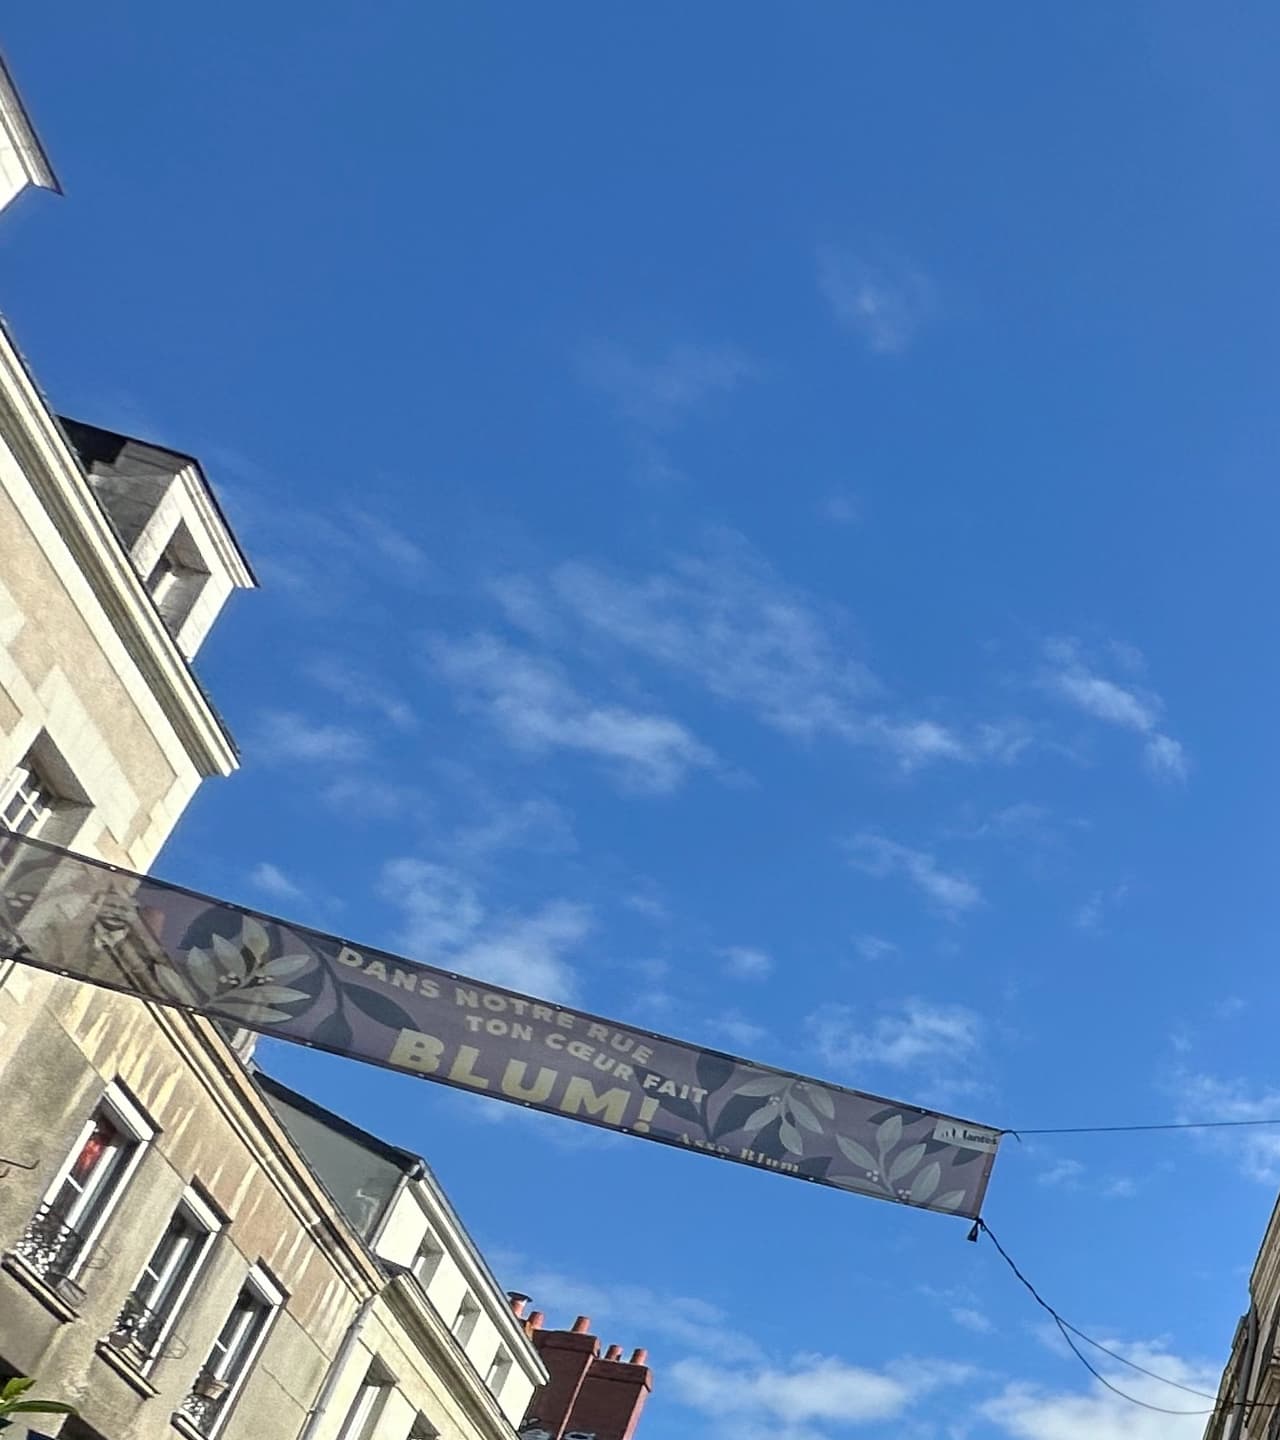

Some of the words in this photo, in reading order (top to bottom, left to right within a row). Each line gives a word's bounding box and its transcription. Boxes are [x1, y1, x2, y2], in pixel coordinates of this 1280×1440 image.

[336, 946, 440, 998] DANS
[455, 987, 576, 1029] NOTRE
[587, 1021, 654, 1065] RUE
[465, 1014, 533, 1042] TON
[545, 1032, 636, 1083] CŒUR
[643, 1073, 709, 1104] FAIT
